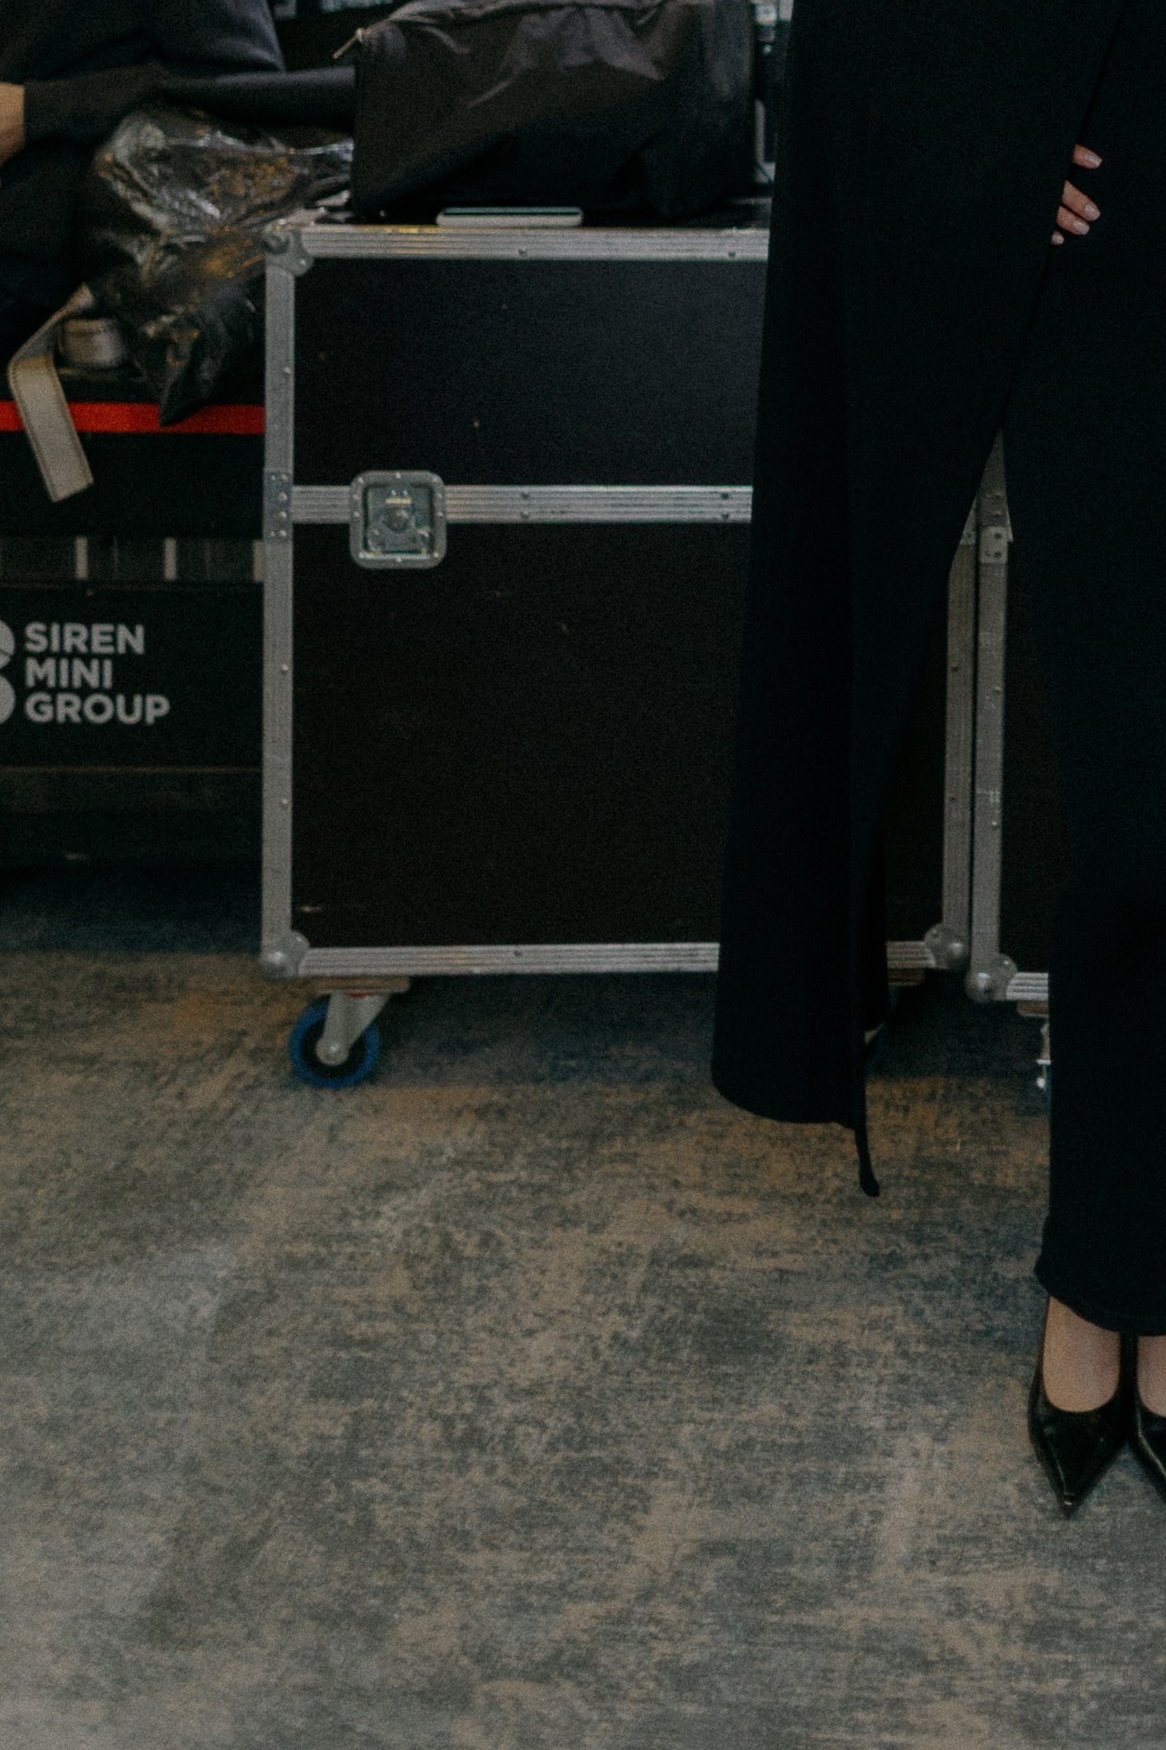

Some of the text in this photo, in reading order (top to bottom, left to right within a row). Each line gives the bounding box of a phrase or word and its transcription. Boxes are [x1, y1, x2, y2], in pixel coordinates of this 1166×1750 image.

[24, 622, 146, 654] SIREN
[25, 657, 113, 689] MINI
[24, 692, 171, 724] GROUP
